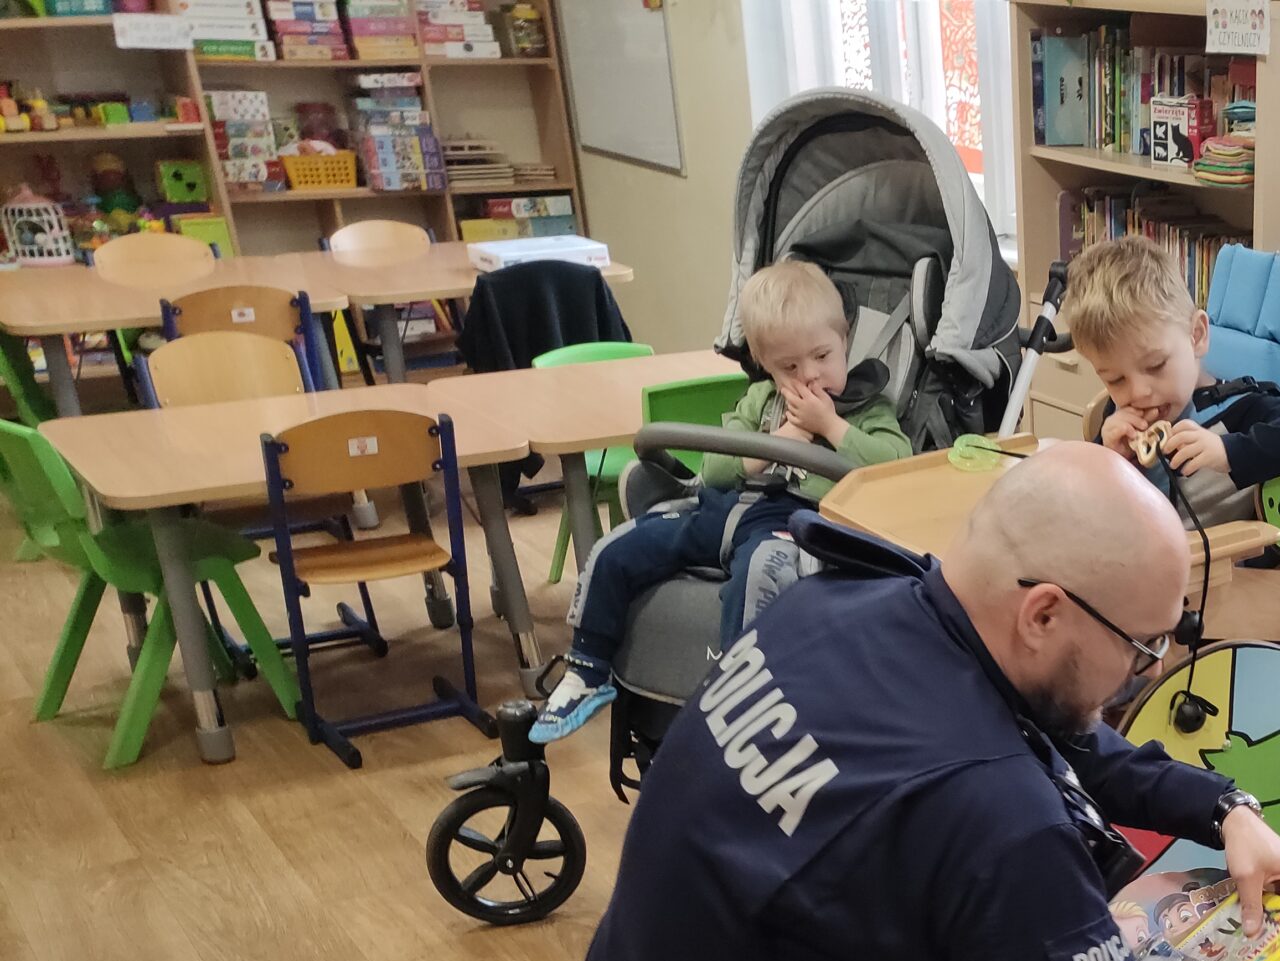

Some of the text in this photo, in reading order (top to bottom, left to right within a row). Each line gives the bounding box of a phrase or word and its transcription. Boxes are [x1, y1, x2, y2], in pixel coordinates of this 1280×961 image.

[1218, 31, 1261, 48] CZYTELNICZY
[1153, 107, 1185, 116] Zwierzęta
[699, 628, 841, 838] POLICJA
